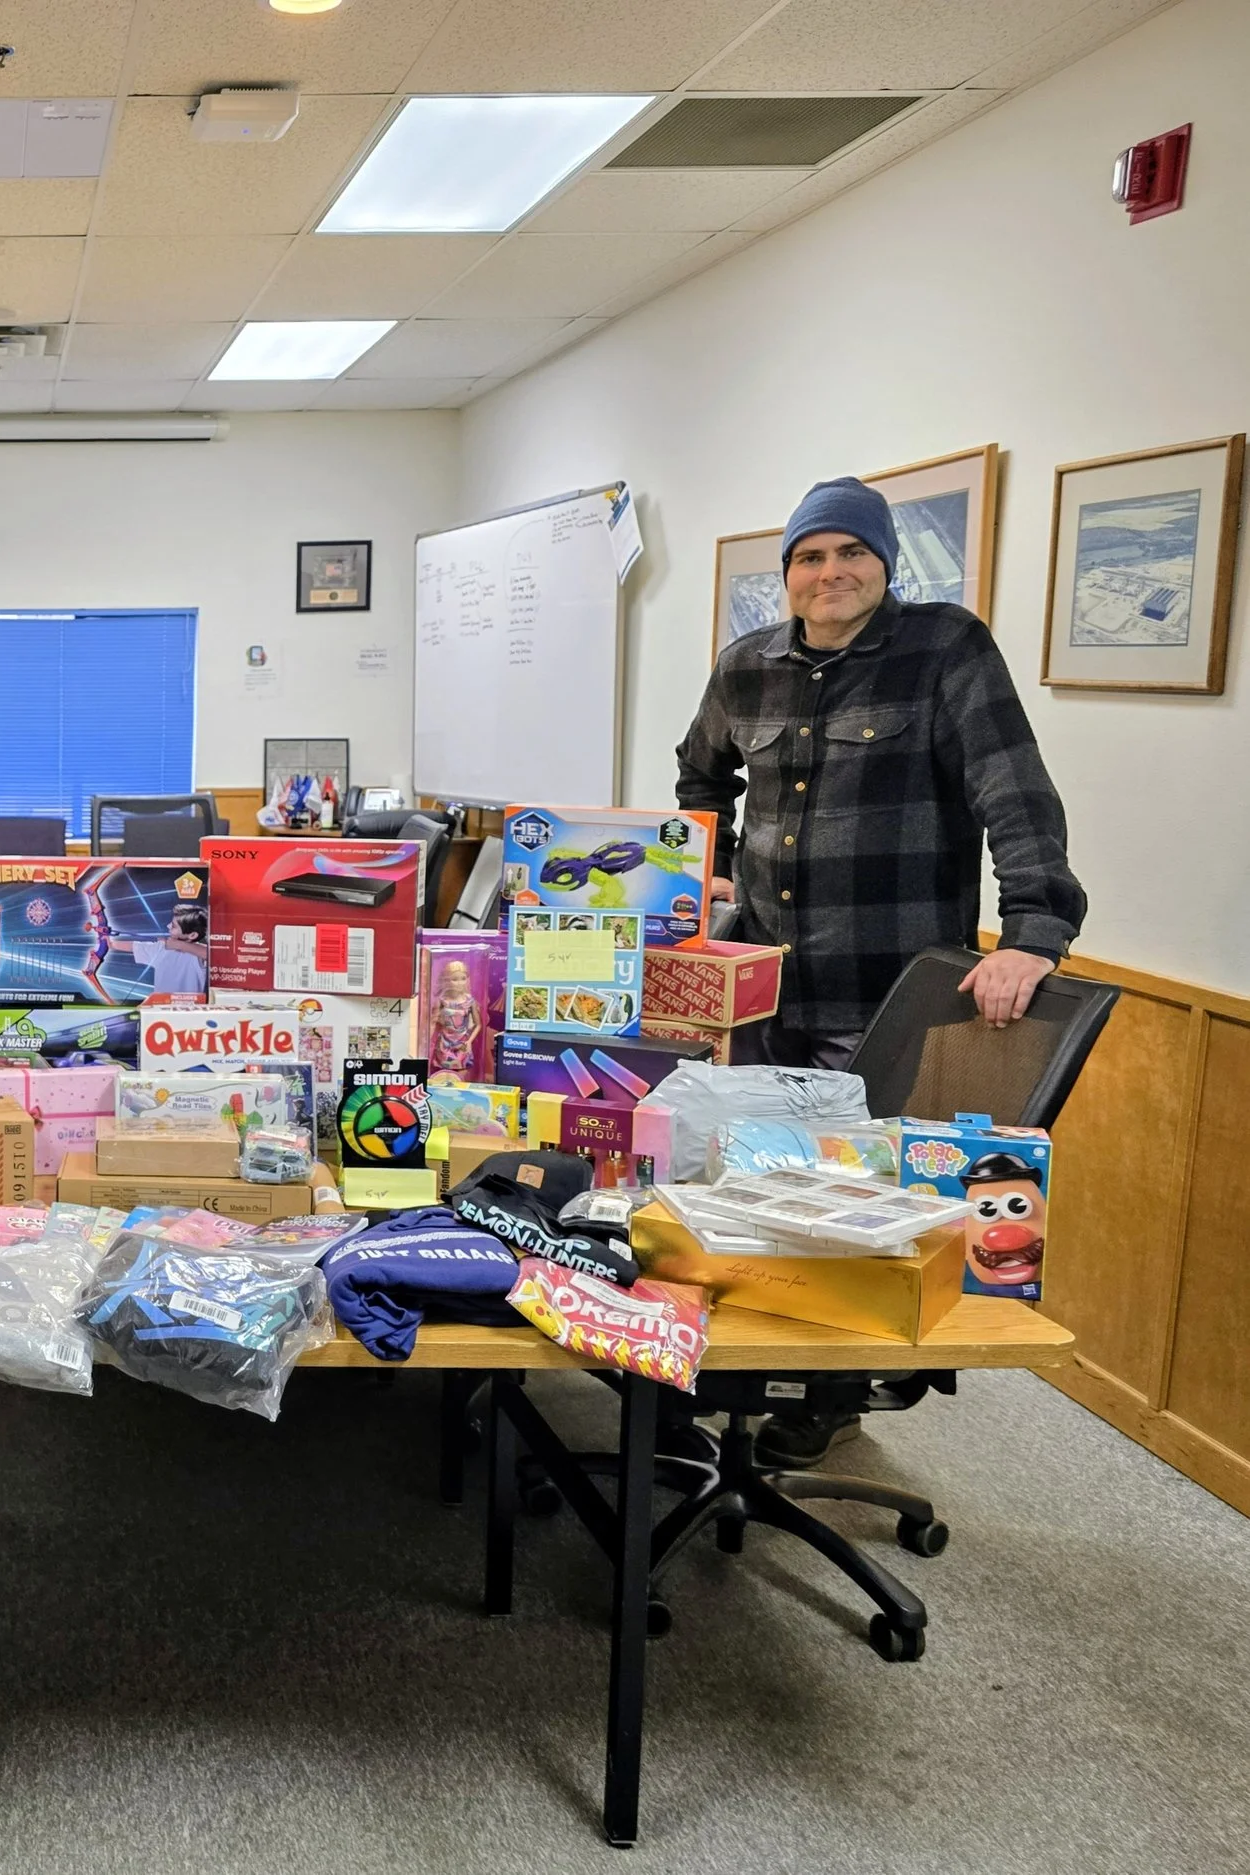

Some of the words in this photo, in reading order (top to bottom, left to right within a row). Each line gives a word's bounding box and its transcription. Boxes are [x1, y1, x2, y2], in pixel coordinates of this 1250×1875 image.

[1131, 152, 1143, 194] FIRE
[511, 822, 556, 837] HEX
[515, 835, 548, 844] BOTS
[211, 849, 258, 860] SONY
[42, 865, 80, 892] SET
[210, 973, 247, 982] VP-SR510H
[247, 968, 267, 977] Player
[651, 965, 680, 991] VANS
[672, 963, 702, 988] VANS
[694, 960, 724, 985] VANS
[738, 967, 754, 981] VANS
[658, 987, 688, 1012] VANS
[680, 984, 710, 1009] VANS
[389, 999, 404, 1017] 4
[7, 1037, 44, 1049] MASTER
[145, 1019, 295, 1058] Qwirkle
[506, 1038, 528, 1047] Govee
[503, 1050, 523, 1059] Govee
[502, 1059, 515, 1067] Light
[353, 1073, 417, 1086] simon
[172, 1102, 193, 1110] Road
[194, 1102, 212, 1110] Tiles
[174, 1095, 210, 1104] Magnetic
[417, 1103, 431, 1121] TRY
[579, 1117, 615, 1129] SO...?
[419, 1121, 431, 1143] ME!
[570, 1127, 623, 1141] UNIQUE
[908, 1140, 964, 1162] Potato
[912, 1157, 961, 1178] Head
[440, 1161, 450, 1193] Fandom
[203, 1197, 219, 1212] CE
[229, 1204, 244, 1212] Made
[251, 1204, 268, 1212] China
[7, 1216, 46, 1224] GIAN
[532, 1242, 619, 1283] HUNTERS
[725, 1262, 754, 1280] Light
[753, 1270, 766, 1281] up
[764, 1275, 788, 1286] your
